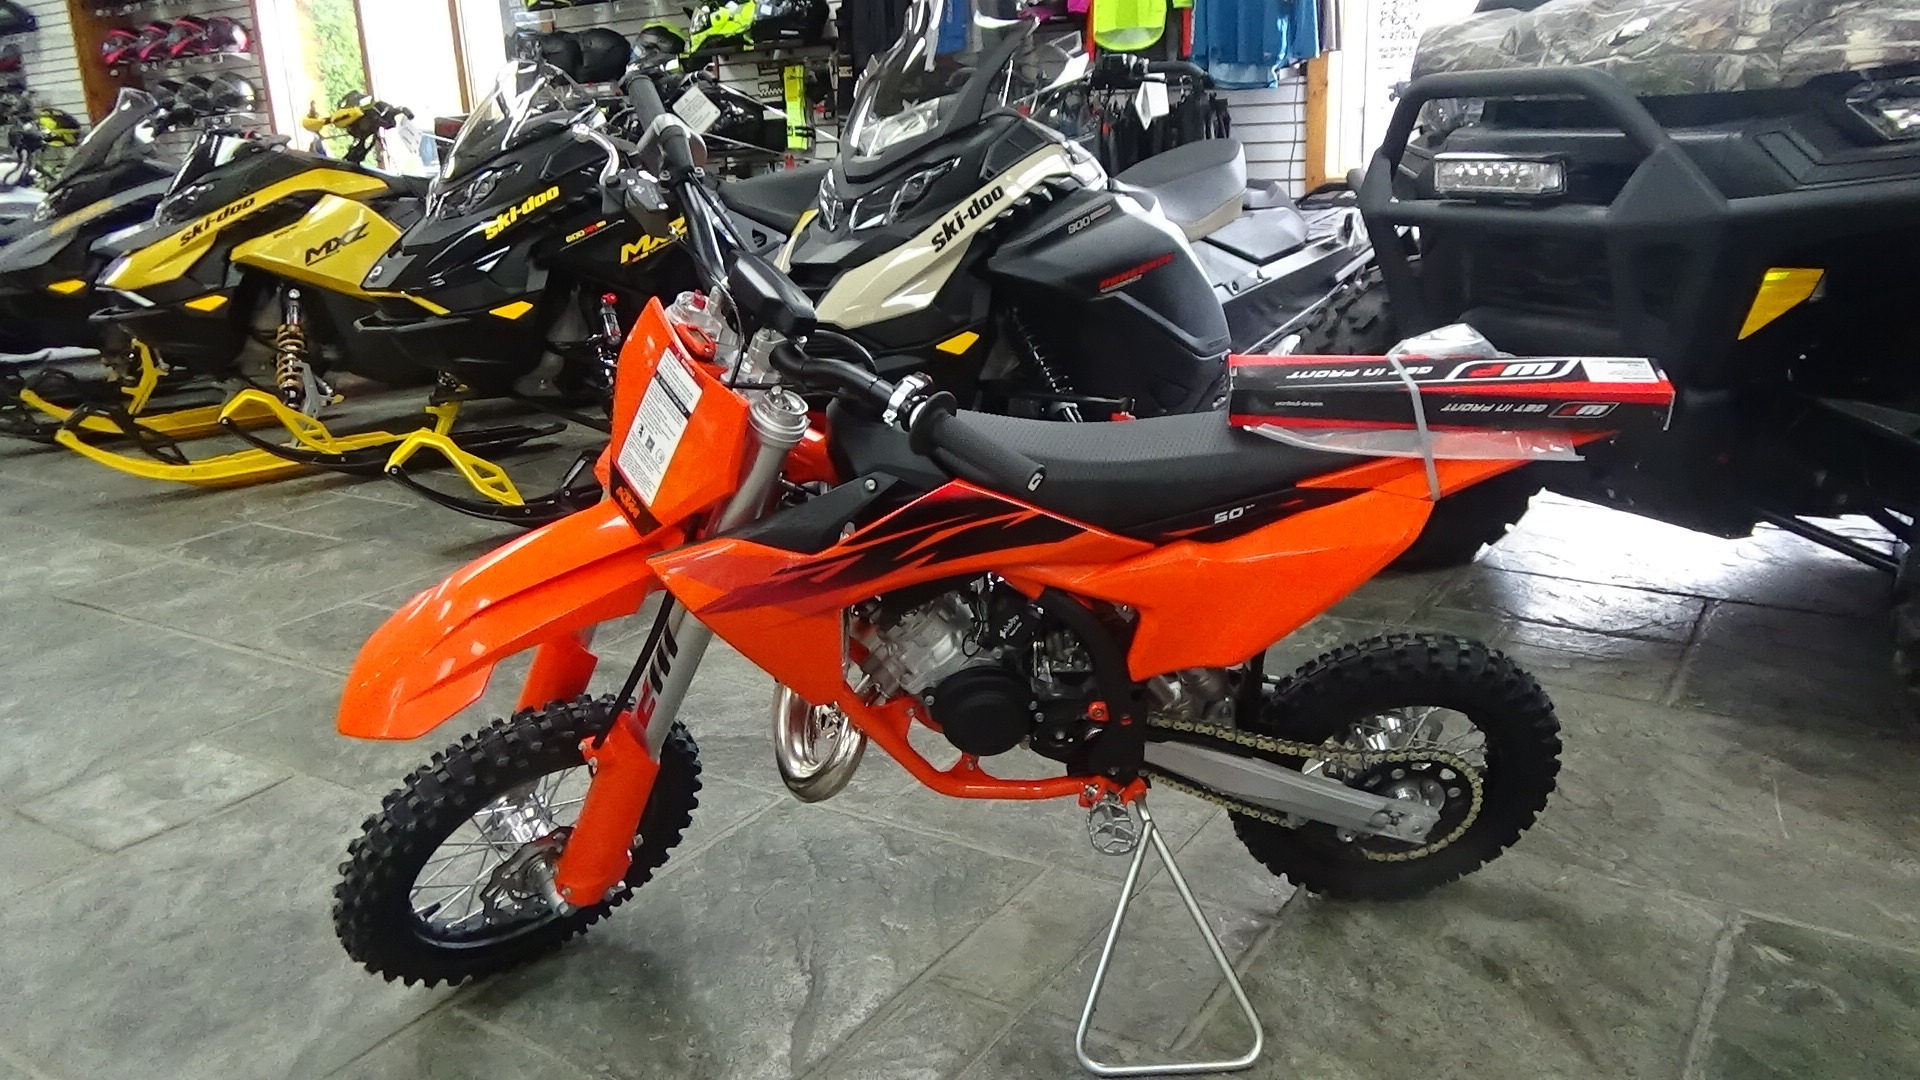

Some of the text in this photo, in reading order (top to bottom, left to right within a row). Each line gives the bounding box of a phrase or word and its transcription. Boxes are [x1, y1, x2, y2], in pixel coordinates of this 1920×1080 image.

[484, 186, 560, 241] ski-doo
[931, 185, 1005, 253] ski-doo
[180, 197, 255, 247] ski-doo
[1286, 369, 1360, 379] FRONT
[1362, 368, 1387, 376] IN
[1440, 403, 1495, 412] FRONT
[1513, 404, 1548, 413] GET
[1214, 507, 1244, 524] 50
